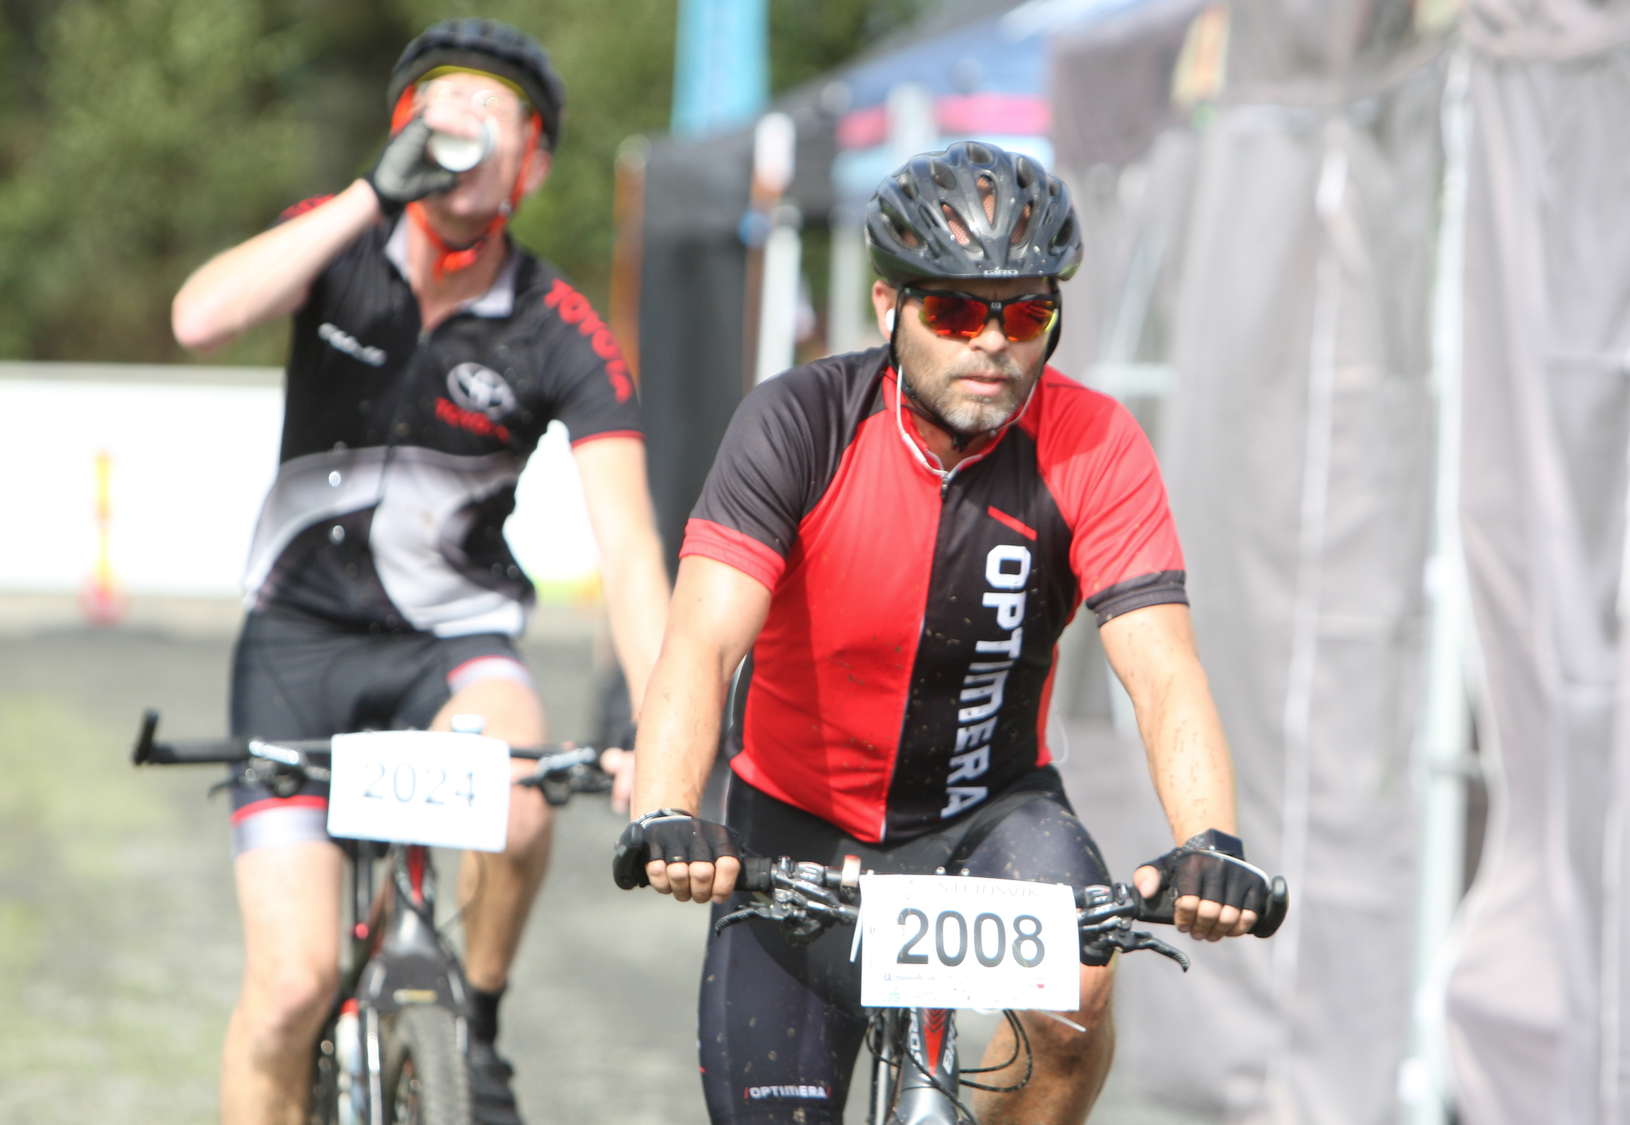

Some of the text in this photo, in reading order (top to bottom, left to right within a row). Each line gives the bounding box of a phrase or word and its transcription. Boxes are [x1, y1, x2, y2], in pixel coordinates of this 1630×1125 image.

[983, 268, 1019, 278] GIRO
[940, 544, 1032, 818] OPTIMERA
[362, 760, 475, 807] 2024
[896, 907, 1046, 968] 2008
[749, 1085, 828, 1100] OPTIMERA
